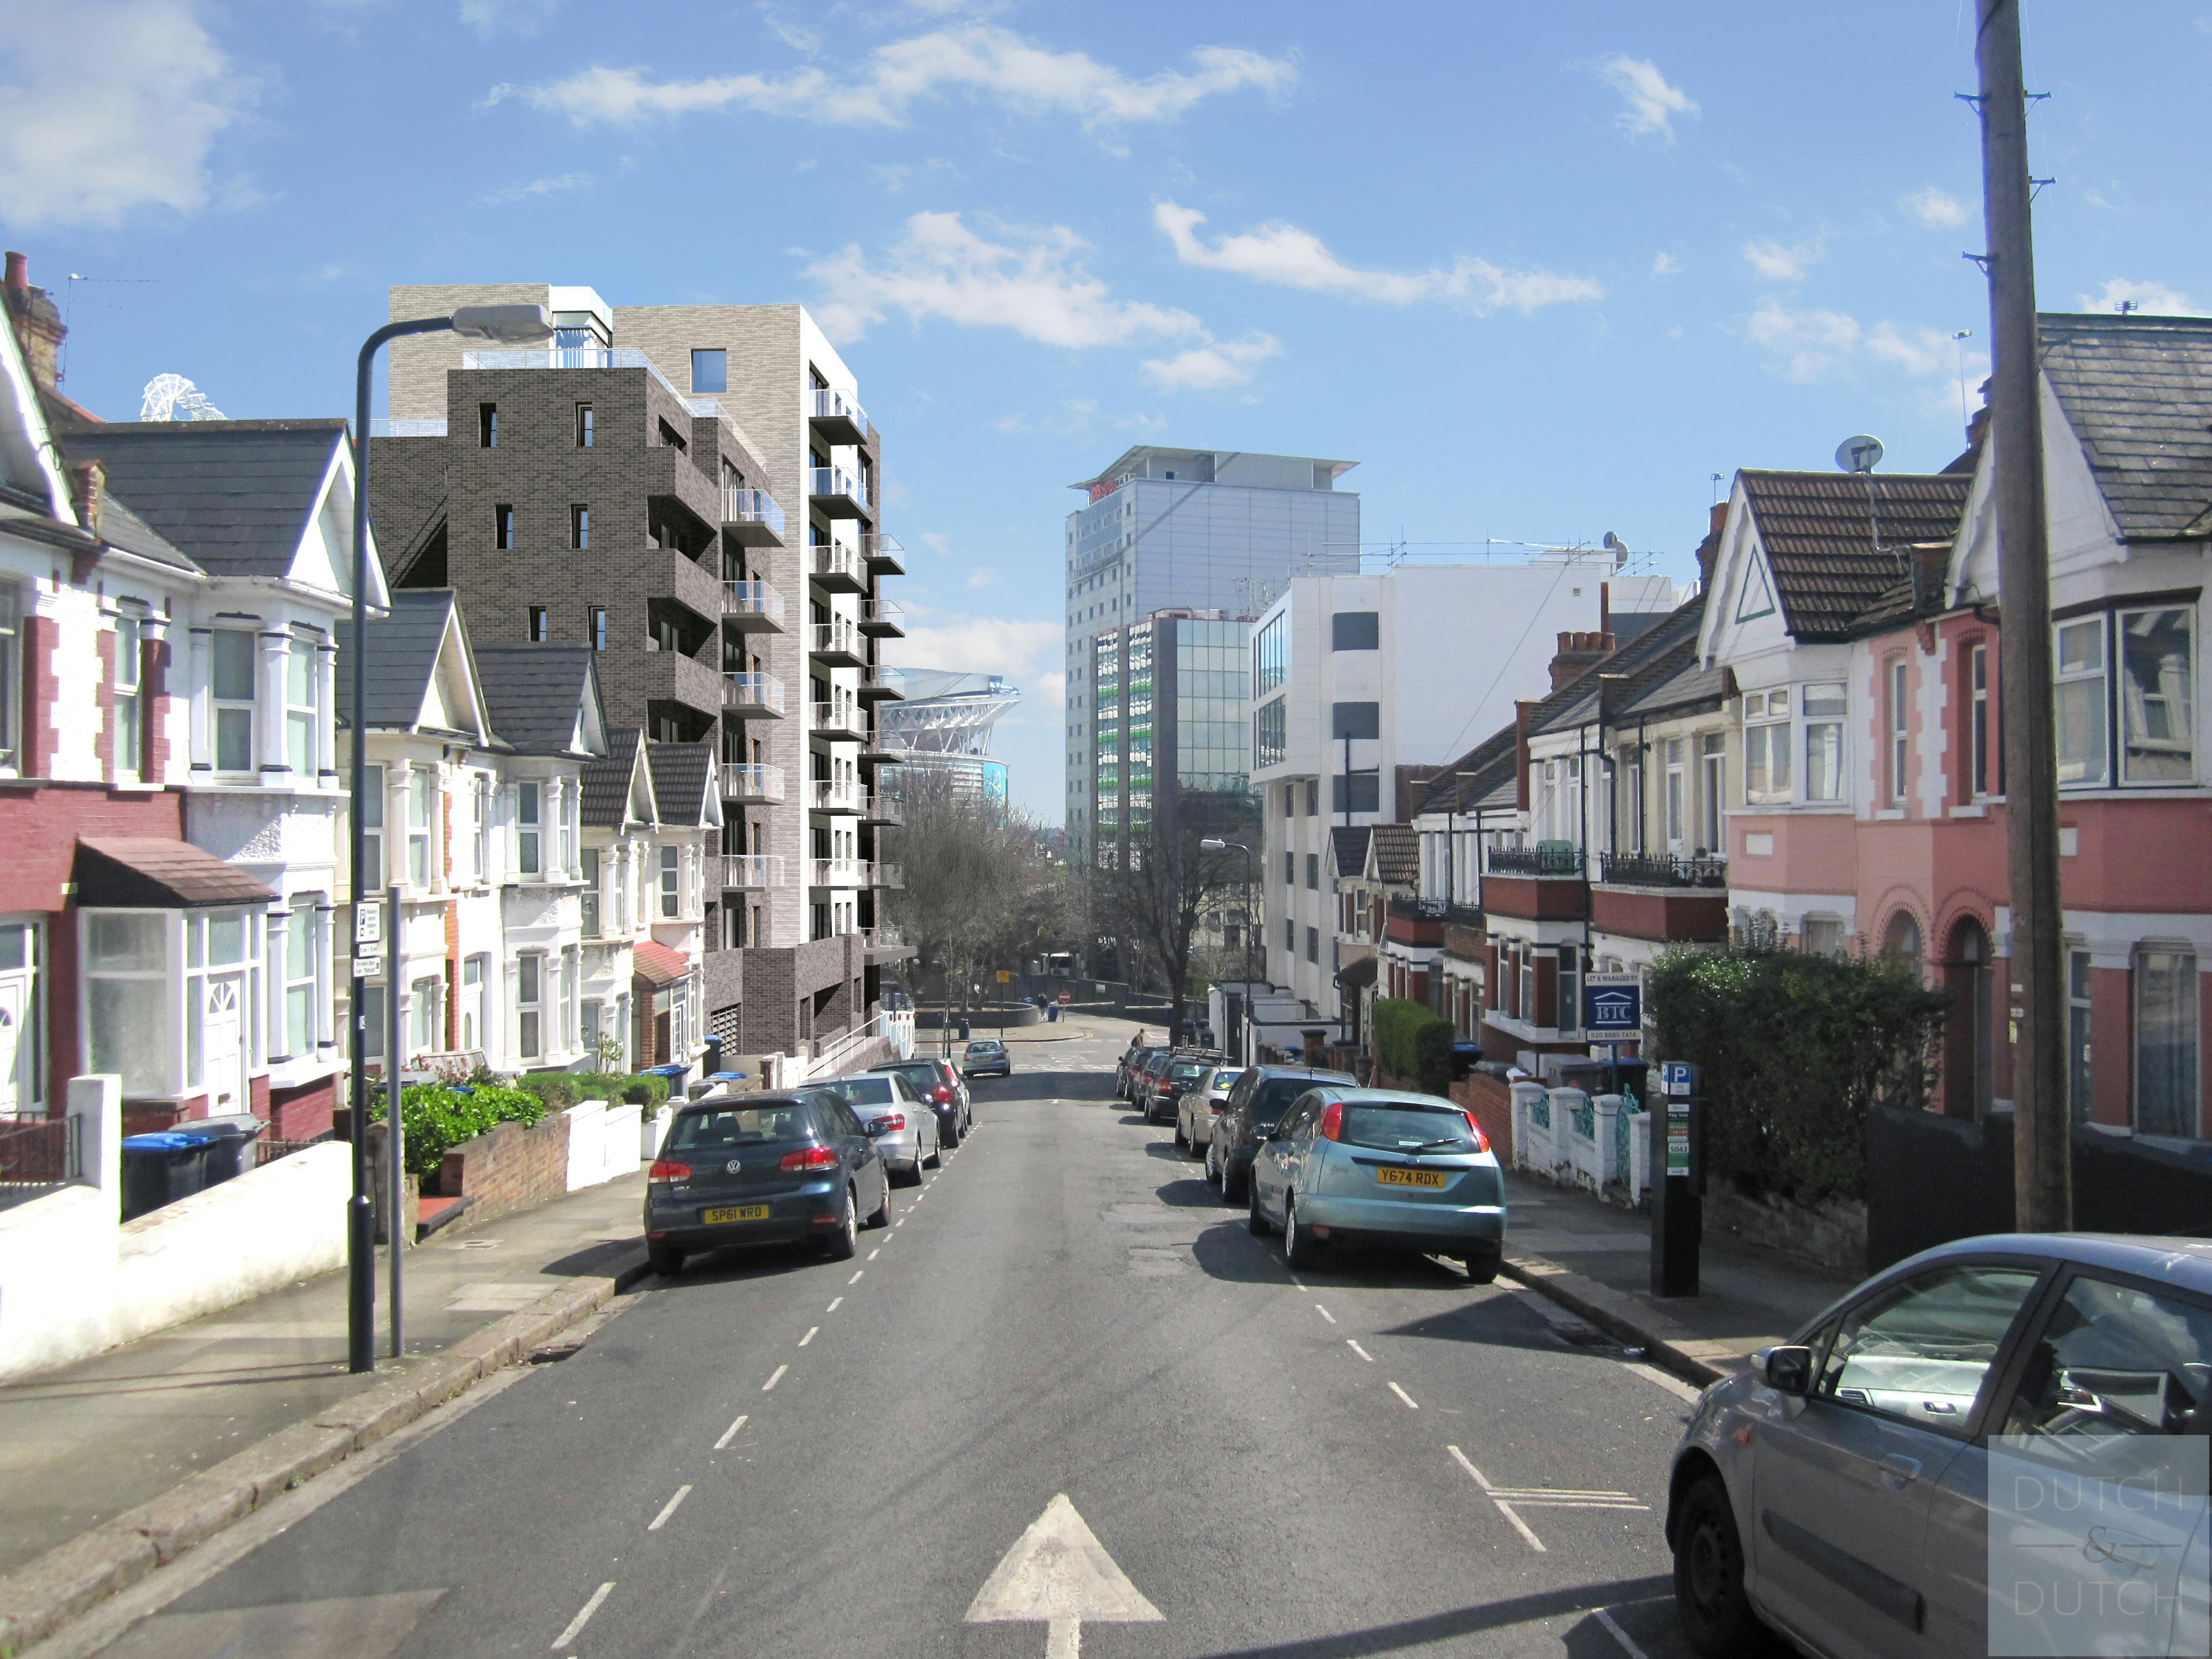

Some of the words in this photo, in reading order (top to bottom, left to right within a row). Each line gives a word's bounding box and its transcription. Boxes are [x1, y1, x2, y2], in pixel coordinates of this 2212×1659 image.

[1597, 1006, 1631, 1019] BTC
[1662, 1065, 1667, 1080] P
[1674, 1067, 1687, 1082] P
[1383, 1170, 1412, 1183] Y674
[1416, 1172, 1439, 1185] RDX
[712, 1208, 737, 1221] SP61
[739, 1207, 761, 1218] WRD
